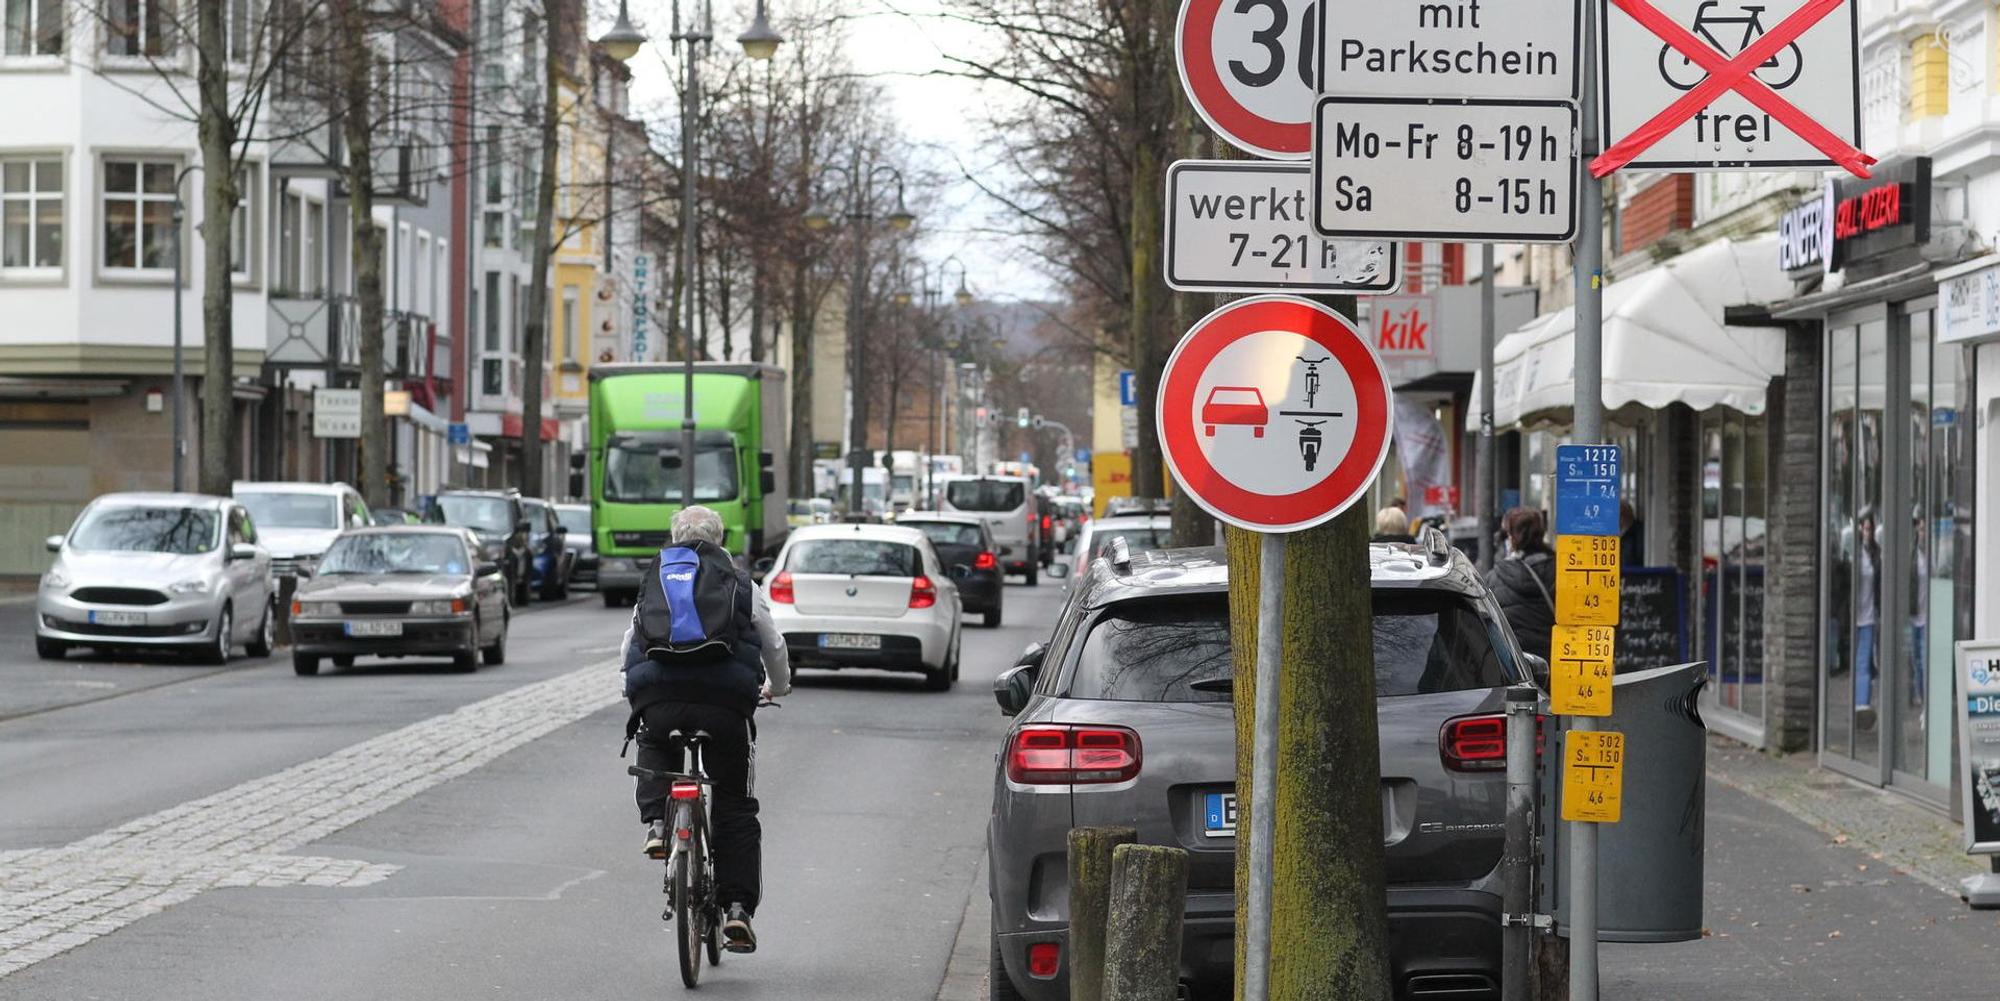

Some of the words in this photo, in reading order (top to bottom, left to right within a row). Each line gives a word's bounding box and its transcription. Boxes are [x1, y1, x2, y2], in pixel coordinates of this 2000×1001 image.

[1419, 0, 1480, 29] mit
[1228, 0, 1314, 91] 3
[1340, 39, 1557, 75] Parkschein
[1336, 122, 1438, 160] Mo-Fr
[1336, 176, 1372, 212] Sa
[1229, 233, 1308, 269] 7-21
[1379, 303, 1428, 350] kik
[1584, 448, 1617, 462] 1212
[1594, 463, 1616, 476] 150
[1584, 504, 1600, 519] 4,9
[1592, 538, 1616, 551] 503
[1593, 553, 1616, 566] 100
[1602, 575, 1616, 589] 1,6
[1584, 594, 1599, 608] 4,3
[1587, 629, 1610, 642] 504
[1587, 644, 1610, 657] 150
[1593, 665, 1608, 679] 4,4
[1578, 685, 1593, 699] 4,6
[1599, 736, 1620, 749] 502
[1600, 750, 1620, 763] 150
[1589, 791, 1604, 805] 4,6
